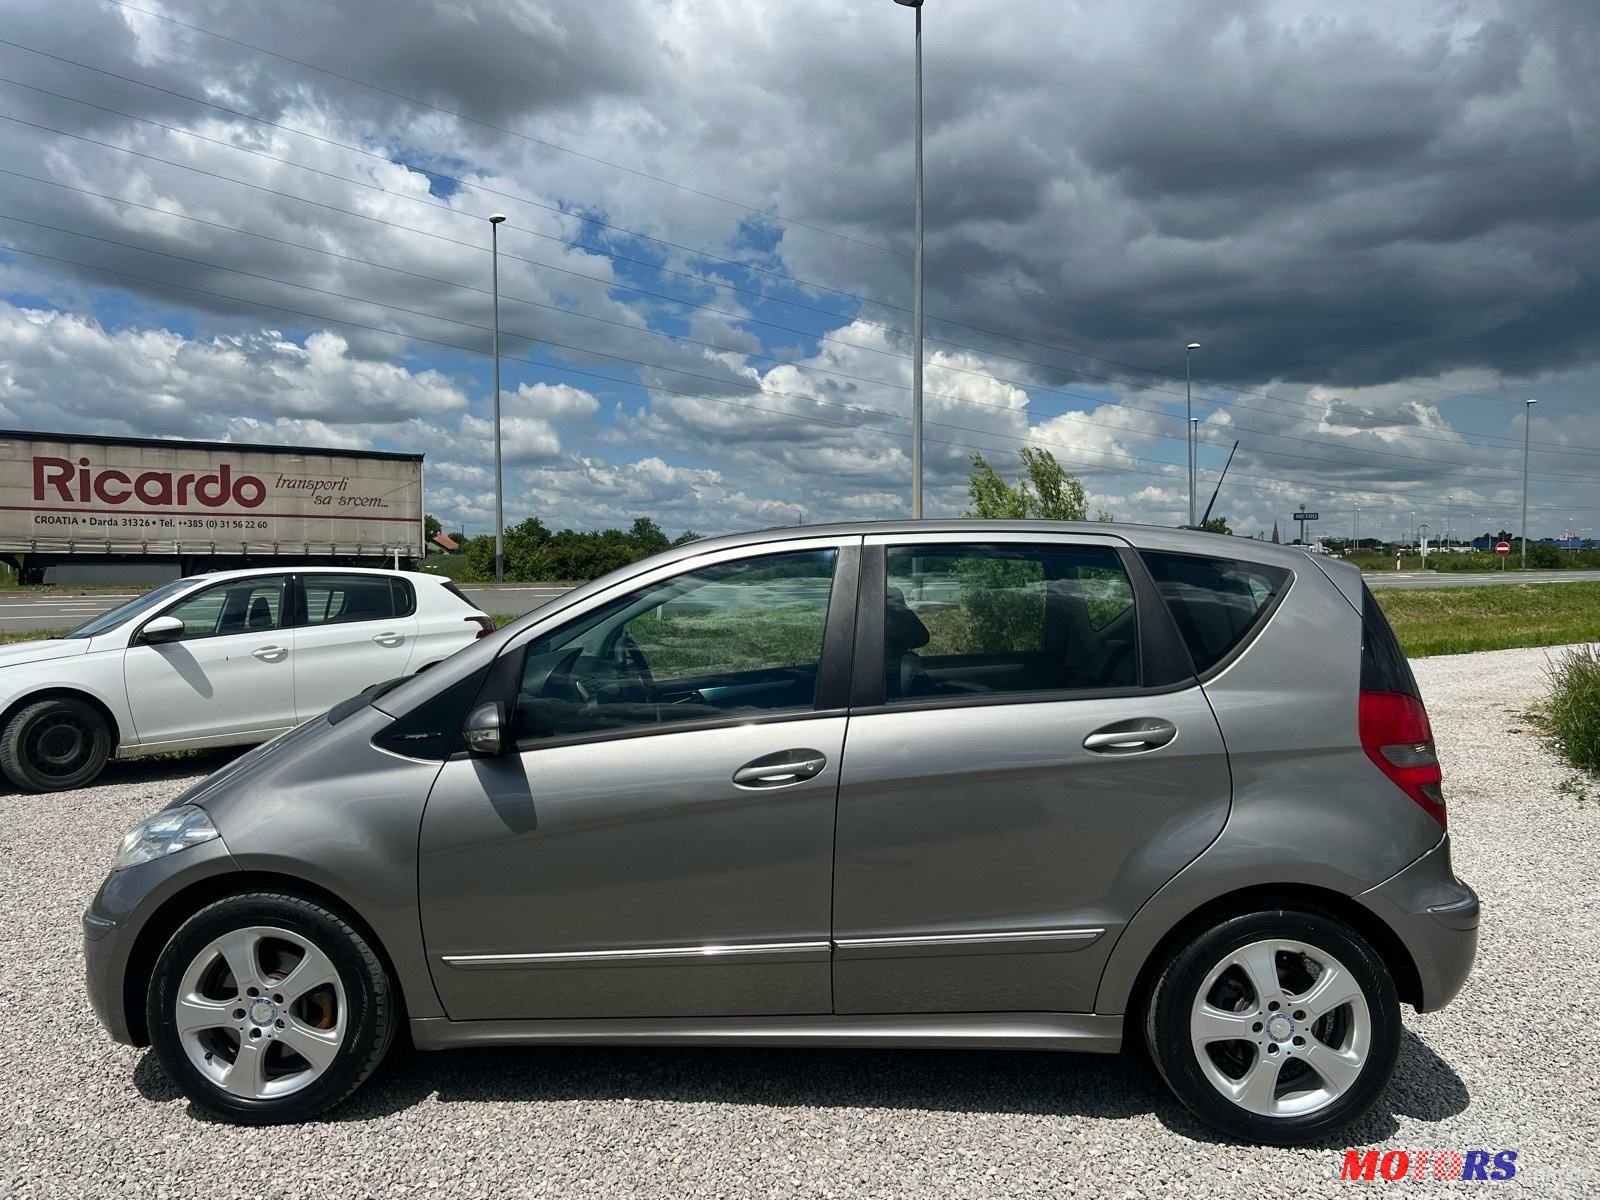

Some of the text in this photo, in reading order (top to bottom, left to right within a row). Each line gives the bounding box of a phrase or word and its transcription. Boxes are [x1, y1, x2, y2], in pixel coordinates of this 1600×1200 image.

[32, 456, 267, 508] Ricardo
[275, 473, 349, 496] transporti
[313, 495, 389, 508] sa srcem...
[34, 515, 79, 525] CROATIA
[89, 517, 119, 527] Darda
[121, 518, 151, 527] 31326
[159, 519, 176, 528] Tel.
[206, 519, 218, 529] (0)
[219, 520, 230, 529] 31
[232, 520, 243, 529] 56
[245, 520, 255, 529] 22
[257, 520, 268, 529] 60
